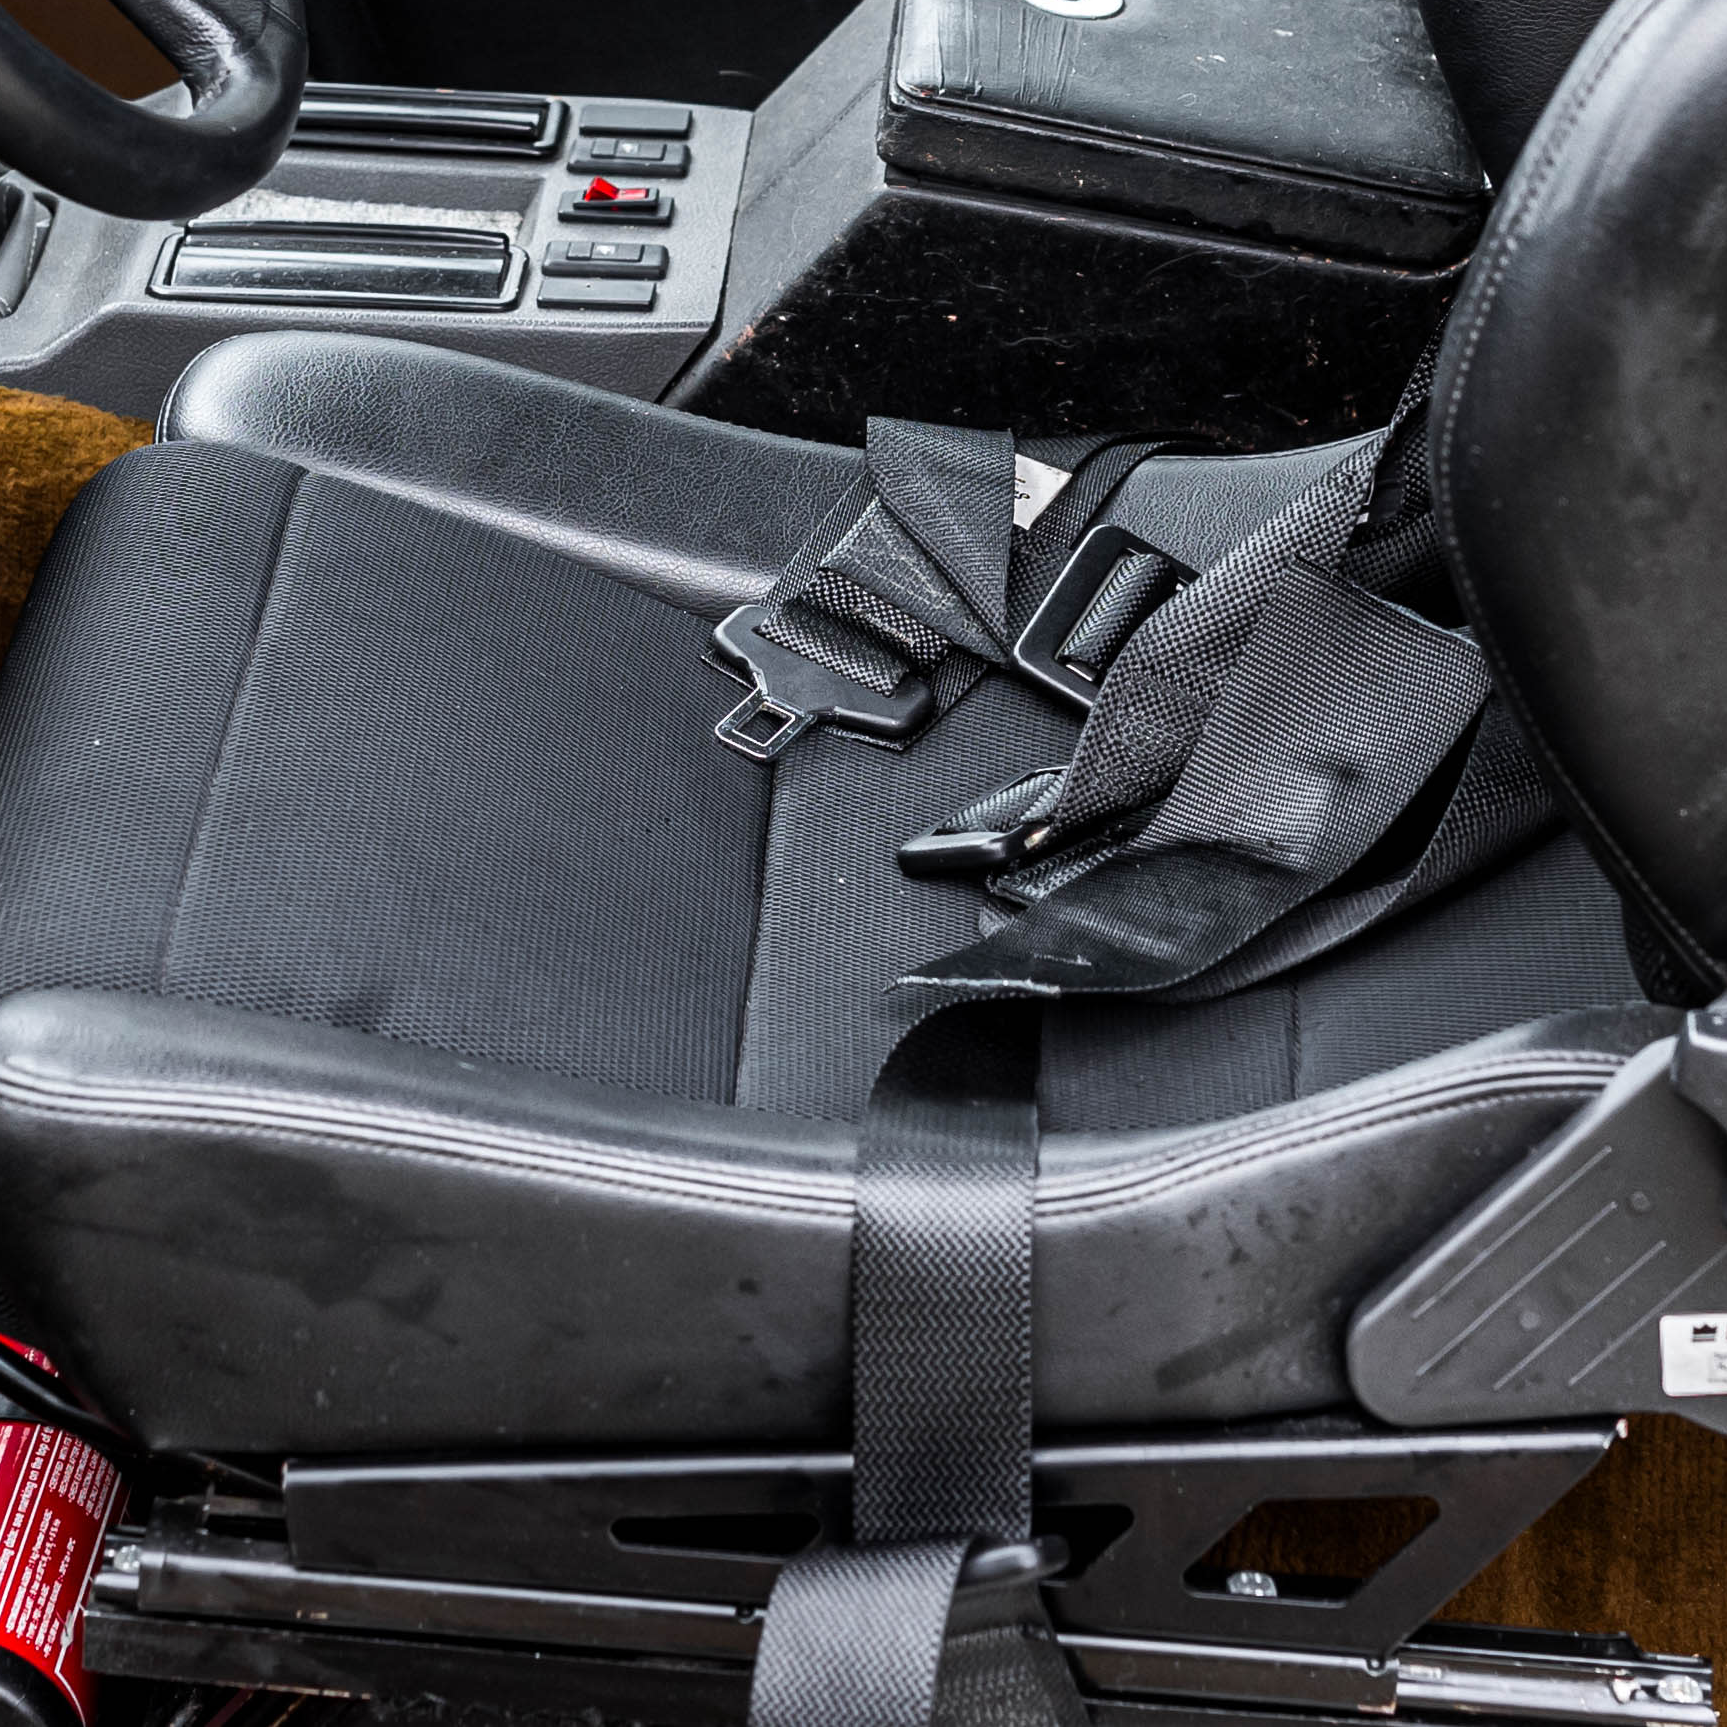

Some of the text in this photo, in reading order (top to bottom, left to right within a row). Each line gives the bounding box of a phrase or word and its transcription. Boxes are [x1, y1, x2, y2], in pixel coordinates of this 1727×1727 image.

[40, 1432, 52, 1443] of
[35, 1442, 51, 1457] top
[28, 1469, 40, 1482] on
